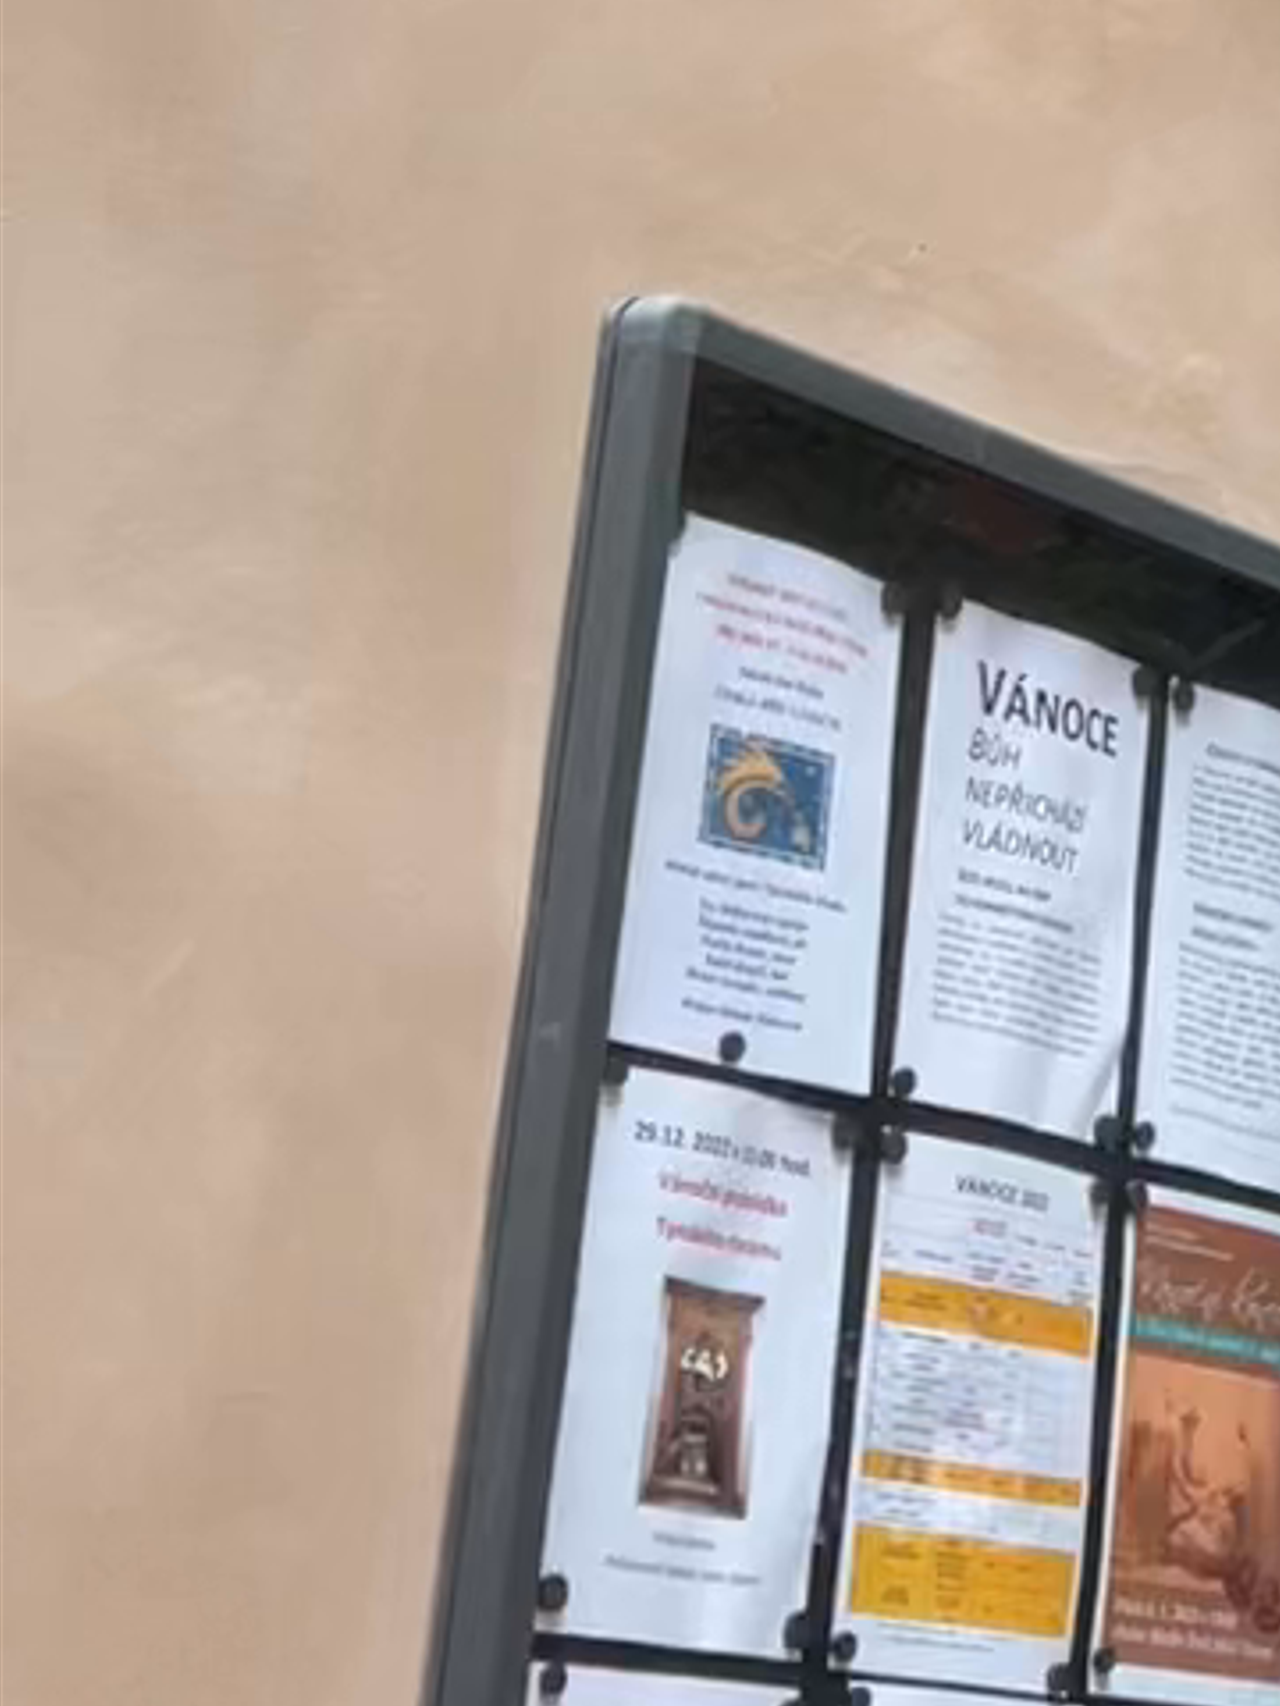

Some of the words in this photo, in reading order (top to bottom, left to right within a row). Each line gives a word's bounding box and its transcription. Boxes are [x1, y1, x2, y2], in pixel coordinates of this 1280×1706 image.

[978, 659, 1119, 759] VÁNOCE
[968, 726, 1022, 770] BŮH
[962, 818, 1079, 874] VLÁDNOUT
